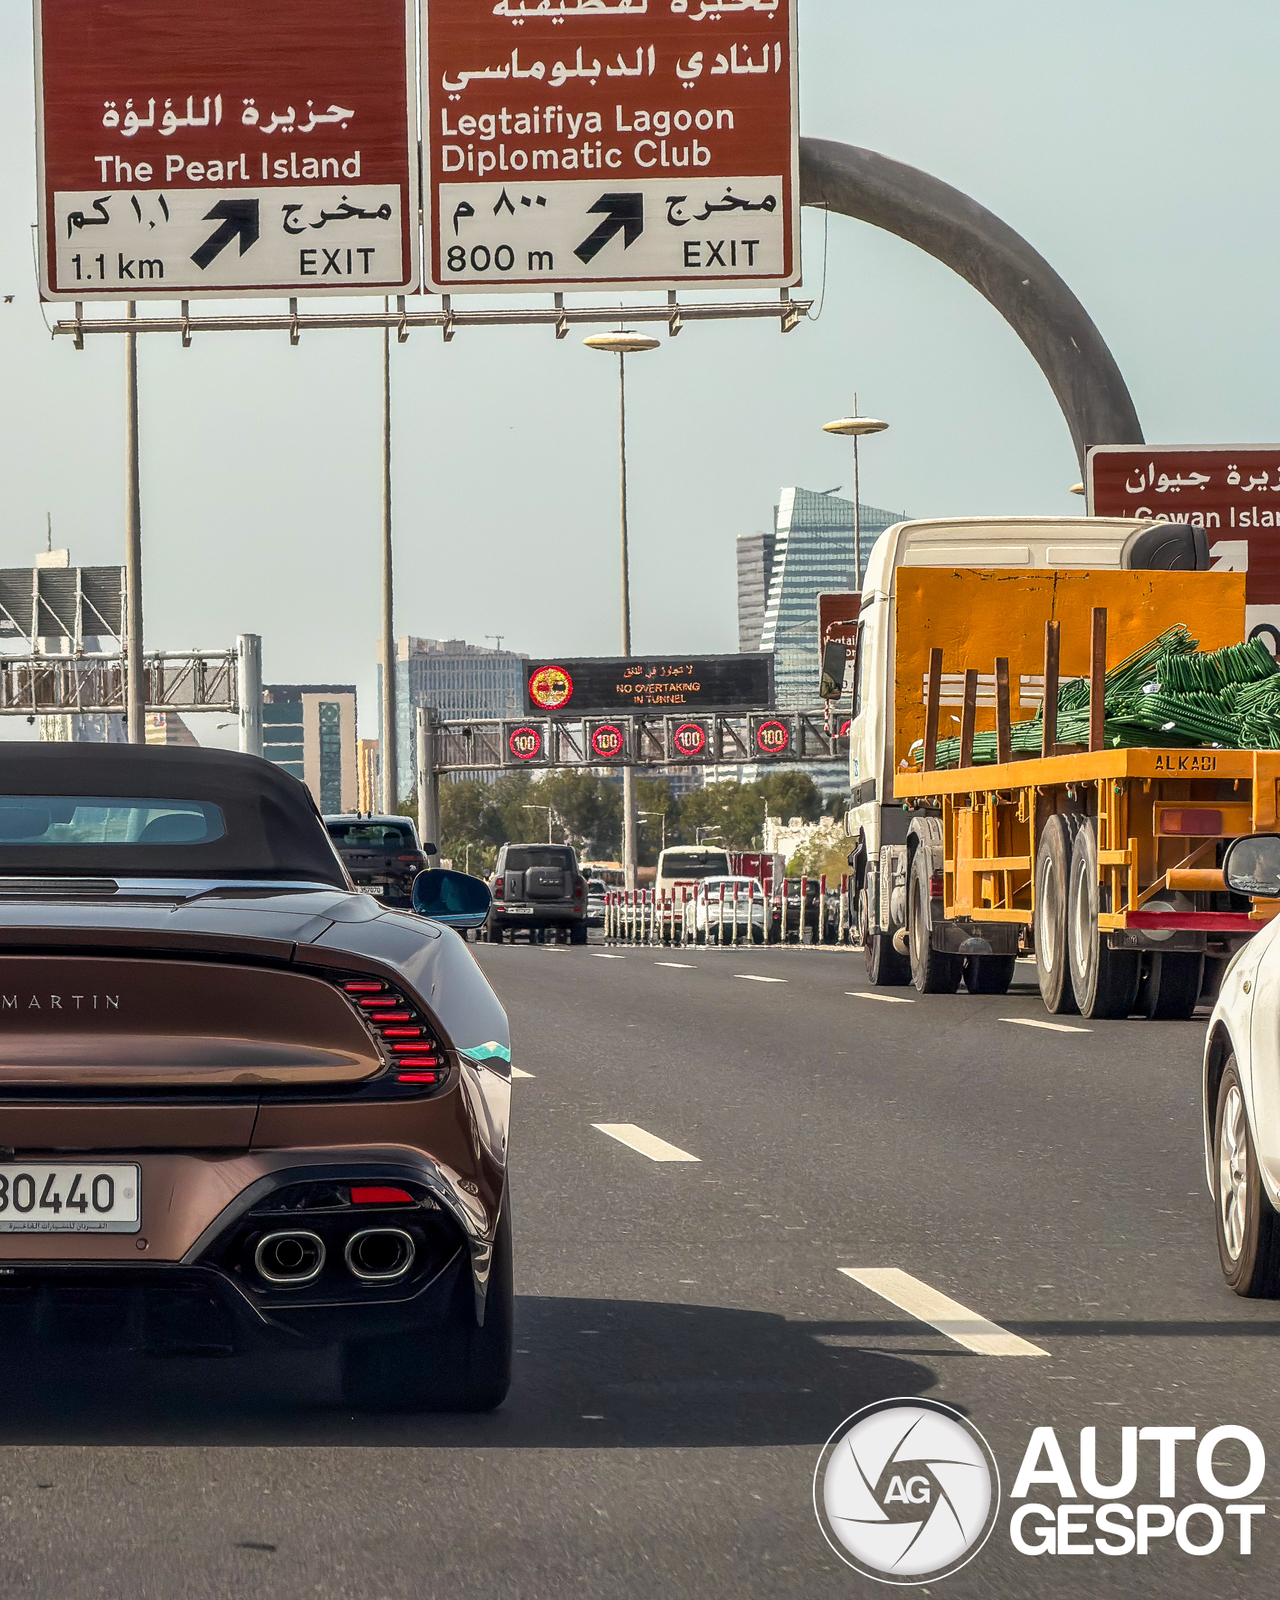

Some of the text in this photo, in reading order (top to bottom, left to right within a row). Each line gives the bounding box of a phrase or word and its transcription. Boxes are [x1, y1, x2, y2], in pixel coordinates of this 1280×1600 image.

[442, 41, 782, 101] النادي الدبلوماسي
[102, 94, 355, 137] جزيرة اللؤلؤة
[441, 104, 734, 141] Legtaifiya Lagoon
[94, 151, 361, 183] The Pearl Island
[441, 139, 712, 177] Diplomatic Club
[67, 195, 112, 240] كم
[281, 193, 393, 234] مخرج
[452, 187, 548, 236] ٨٠٠ م
[665, 185, 777, 226] مخرج
[71, 252, 165, 280] 1.1 km
[299, 247, 376, 276] EXIT
[447, 244, 555, 273] 800 m
[682, 240, 760, 268] EXIT
[1125, 461, 1211, 494] جيوان
[1230, 506, 1280, 527] Isla
[616, 682, 701, 694] NO OVERTAKING
[633, 694, 687, 704] IN TUNNEL
[514, 735, 535, 751] 100
[597, 734, 618, 749] 100
[678, 731, 700, 747] 100
[761, 730, 783, 745] 100
[1155, 755, 1217, 771] ALKADI
[2, 994, 121, 1010] MARTIN
